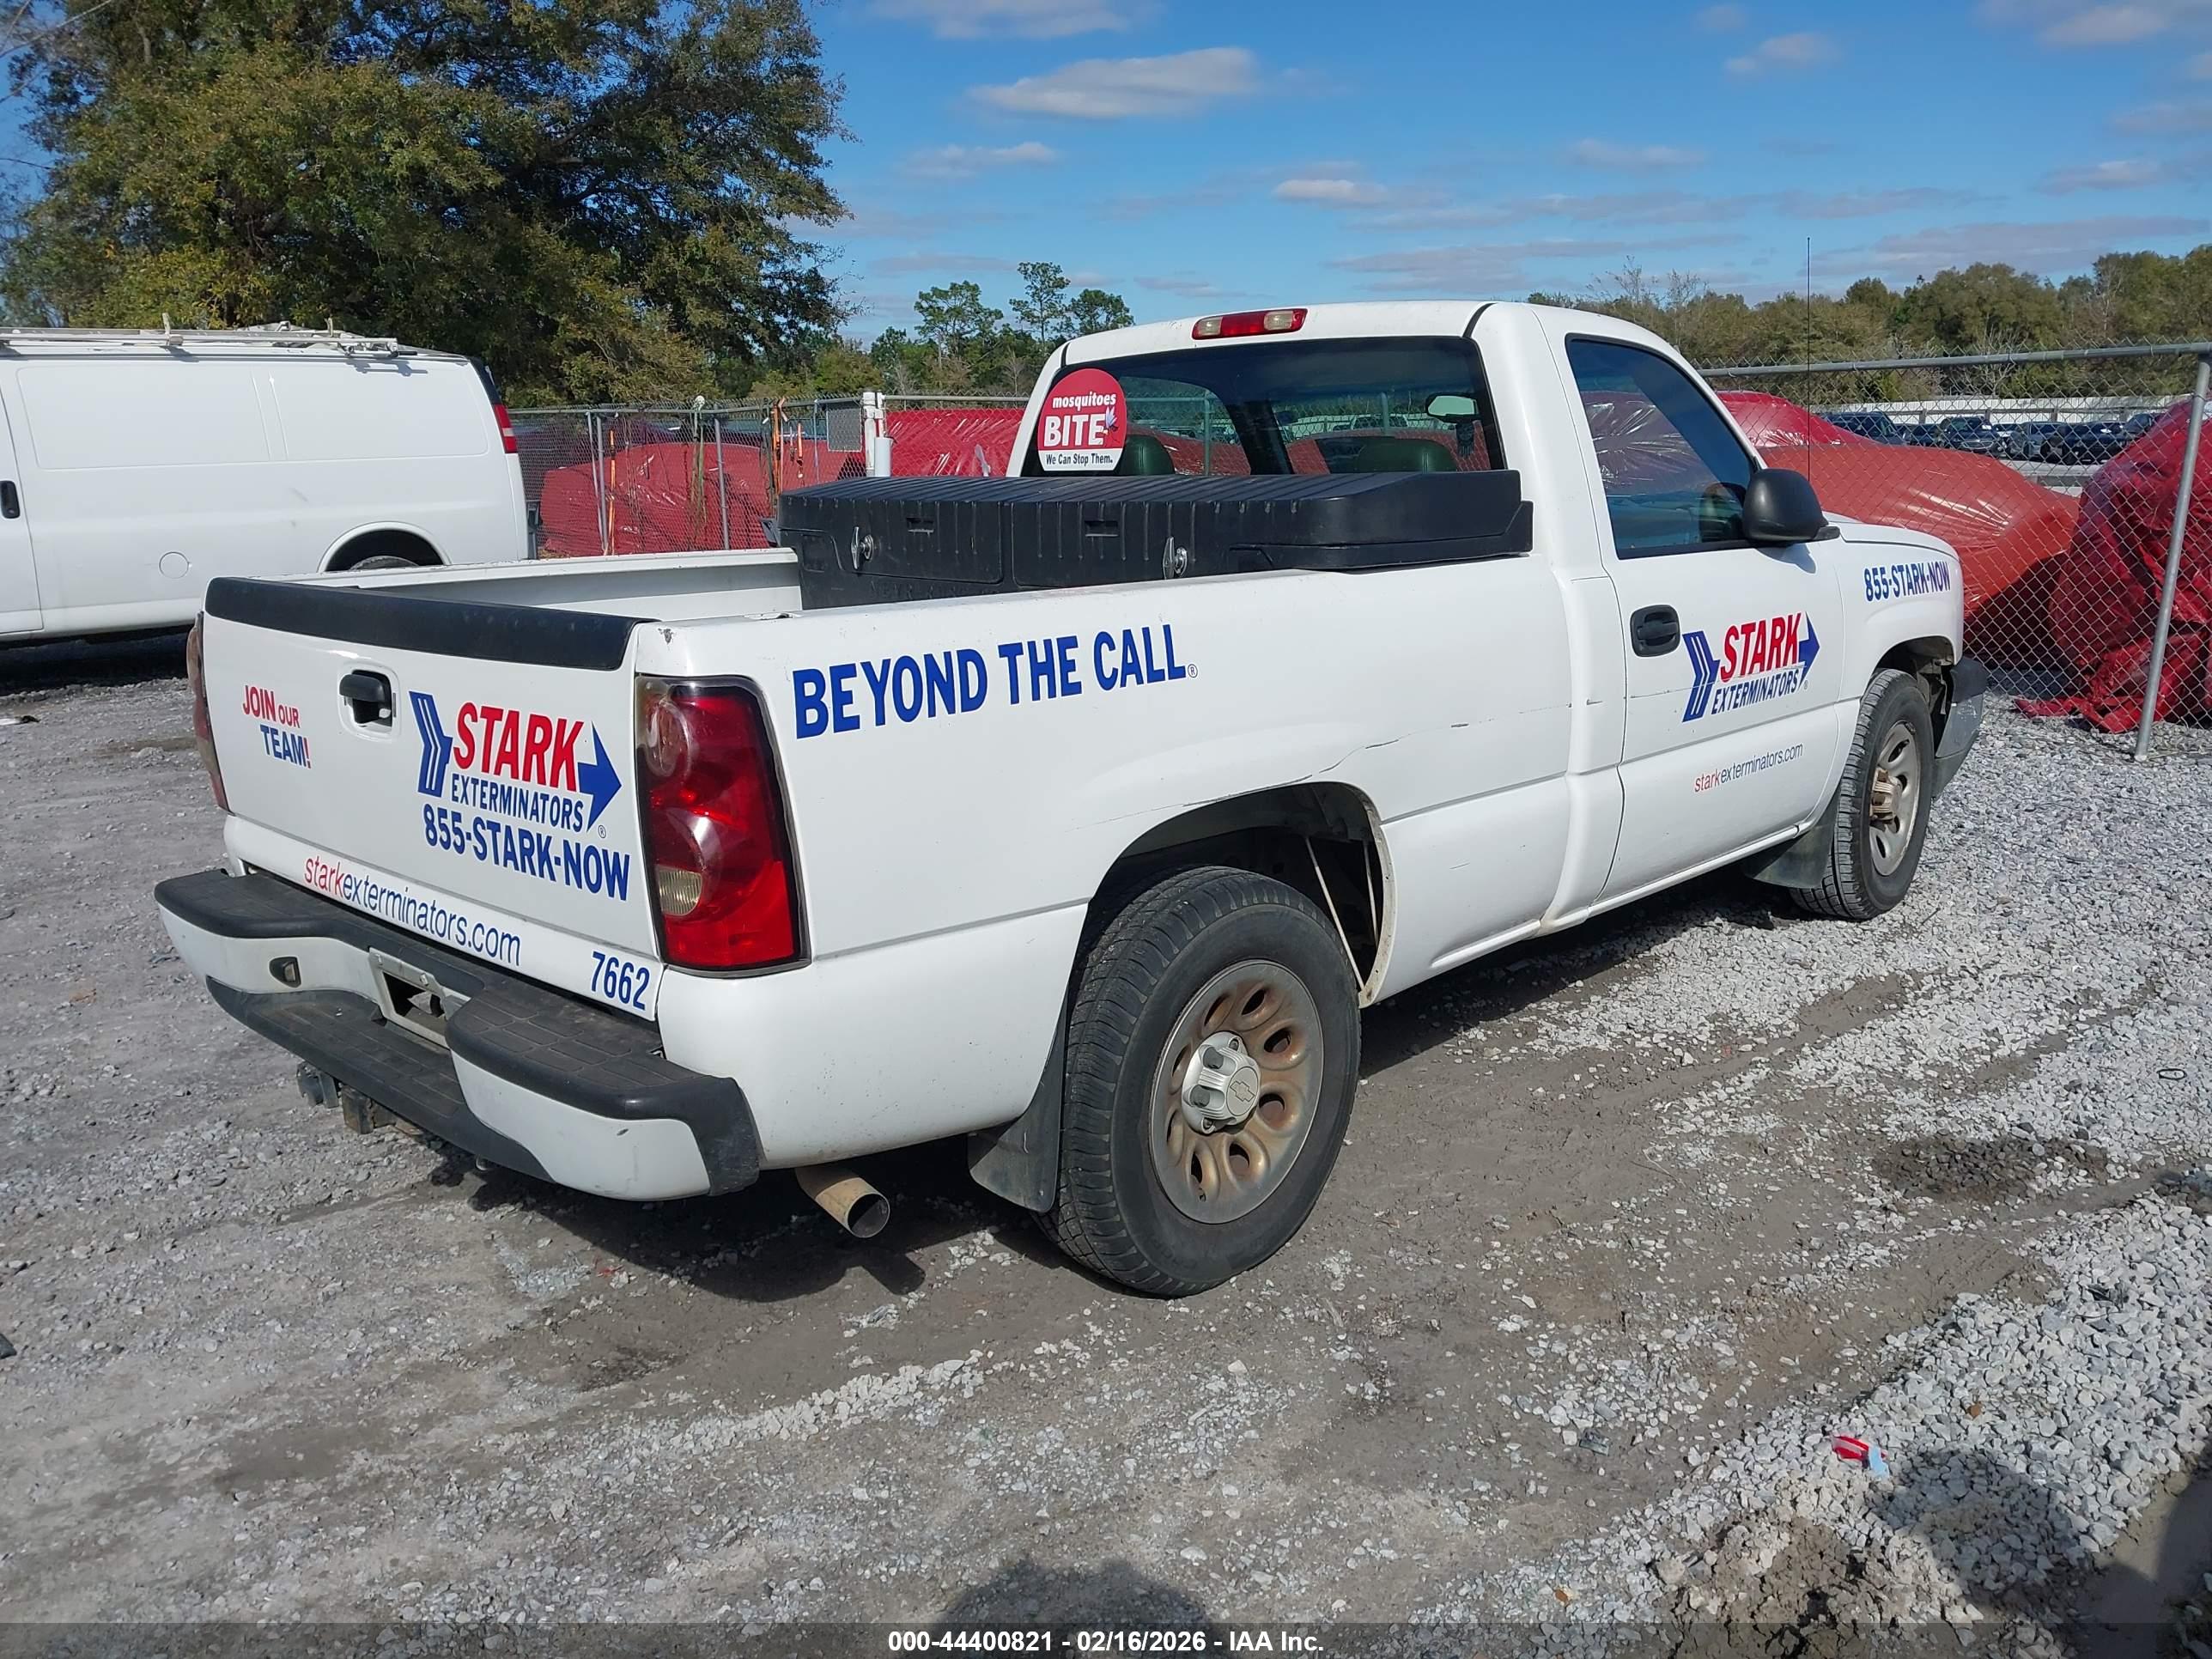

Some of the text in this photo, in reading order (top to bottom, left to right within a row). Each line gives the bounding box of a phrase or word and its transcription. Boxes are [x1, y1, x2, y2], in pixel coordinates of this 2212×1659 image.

[1052, 392, 1116, 411] mosquitoes
[1043, 414, 1105, 447] BITE
[1046, 454, 1056, 465] We
[1058, 453, 1072, 465] Can
[1073, 453, 1089, 467] Stop
[1864, 561, 1951, 601] 855-STARK-NOW
[1720, 613, 1802, 683] STARK
[242, 685, 300, 728] JOIN OUR
[792, 648, 988, 739] BEYOND
[998, 635, 1083, 705] THE
[1711, 669, 1800, 715] EXTERMINATORS
[260, 725, 312, 769] TEAM!
[453, 702, 584, 792] STARK
[1694, 743, 1803, 793] starkexterminators.com
[451, 774, 584, 831] EXTERMINATORS
[422, 804, 630, 901] 855-STARK-NOW
[304, 855, 521, 965] starkexterminators.com
[590, 951, 650, 1010] 7662
